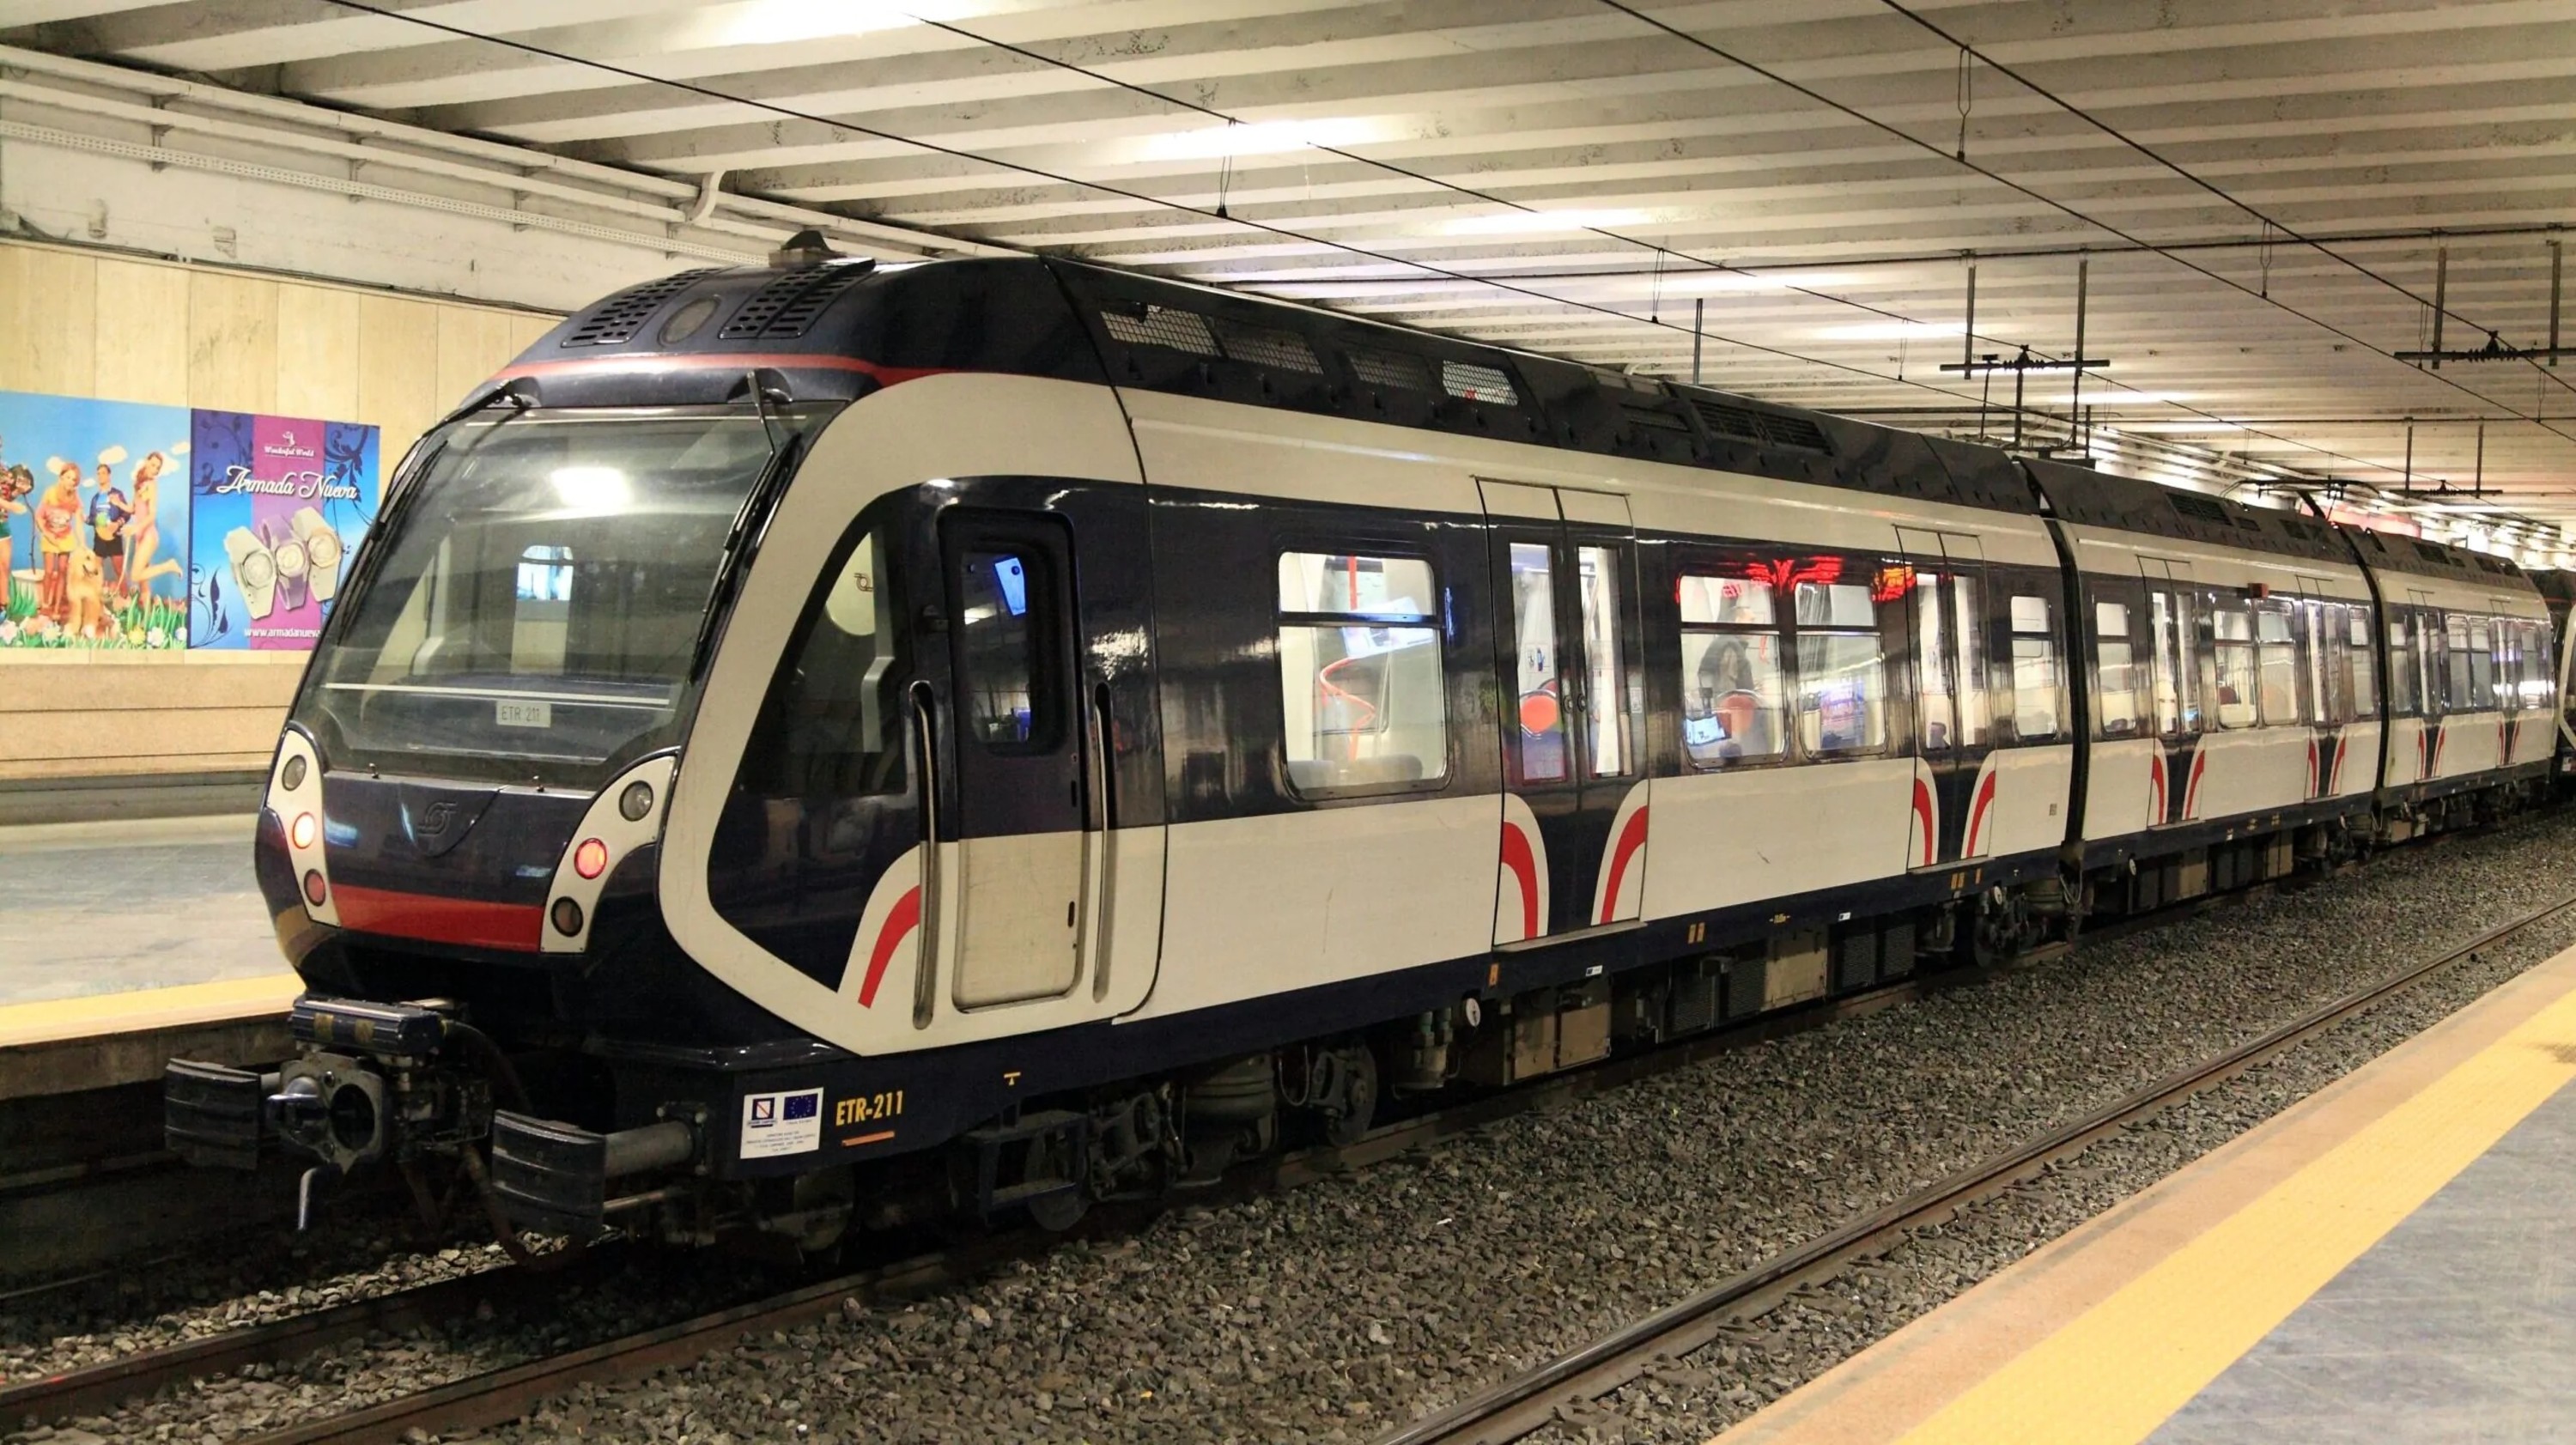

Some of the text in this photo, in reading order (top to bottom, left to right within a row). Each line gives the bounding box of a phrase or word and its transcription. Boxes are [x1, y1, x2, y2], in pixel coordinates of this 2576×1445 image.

[264, 446, 314, 457] Wonderful World
[216, 465, 357, 499] Armada Nueva
[501, 706, 540, 722] ETR 211
[835, 1090, 902, 1126] ETR-211
